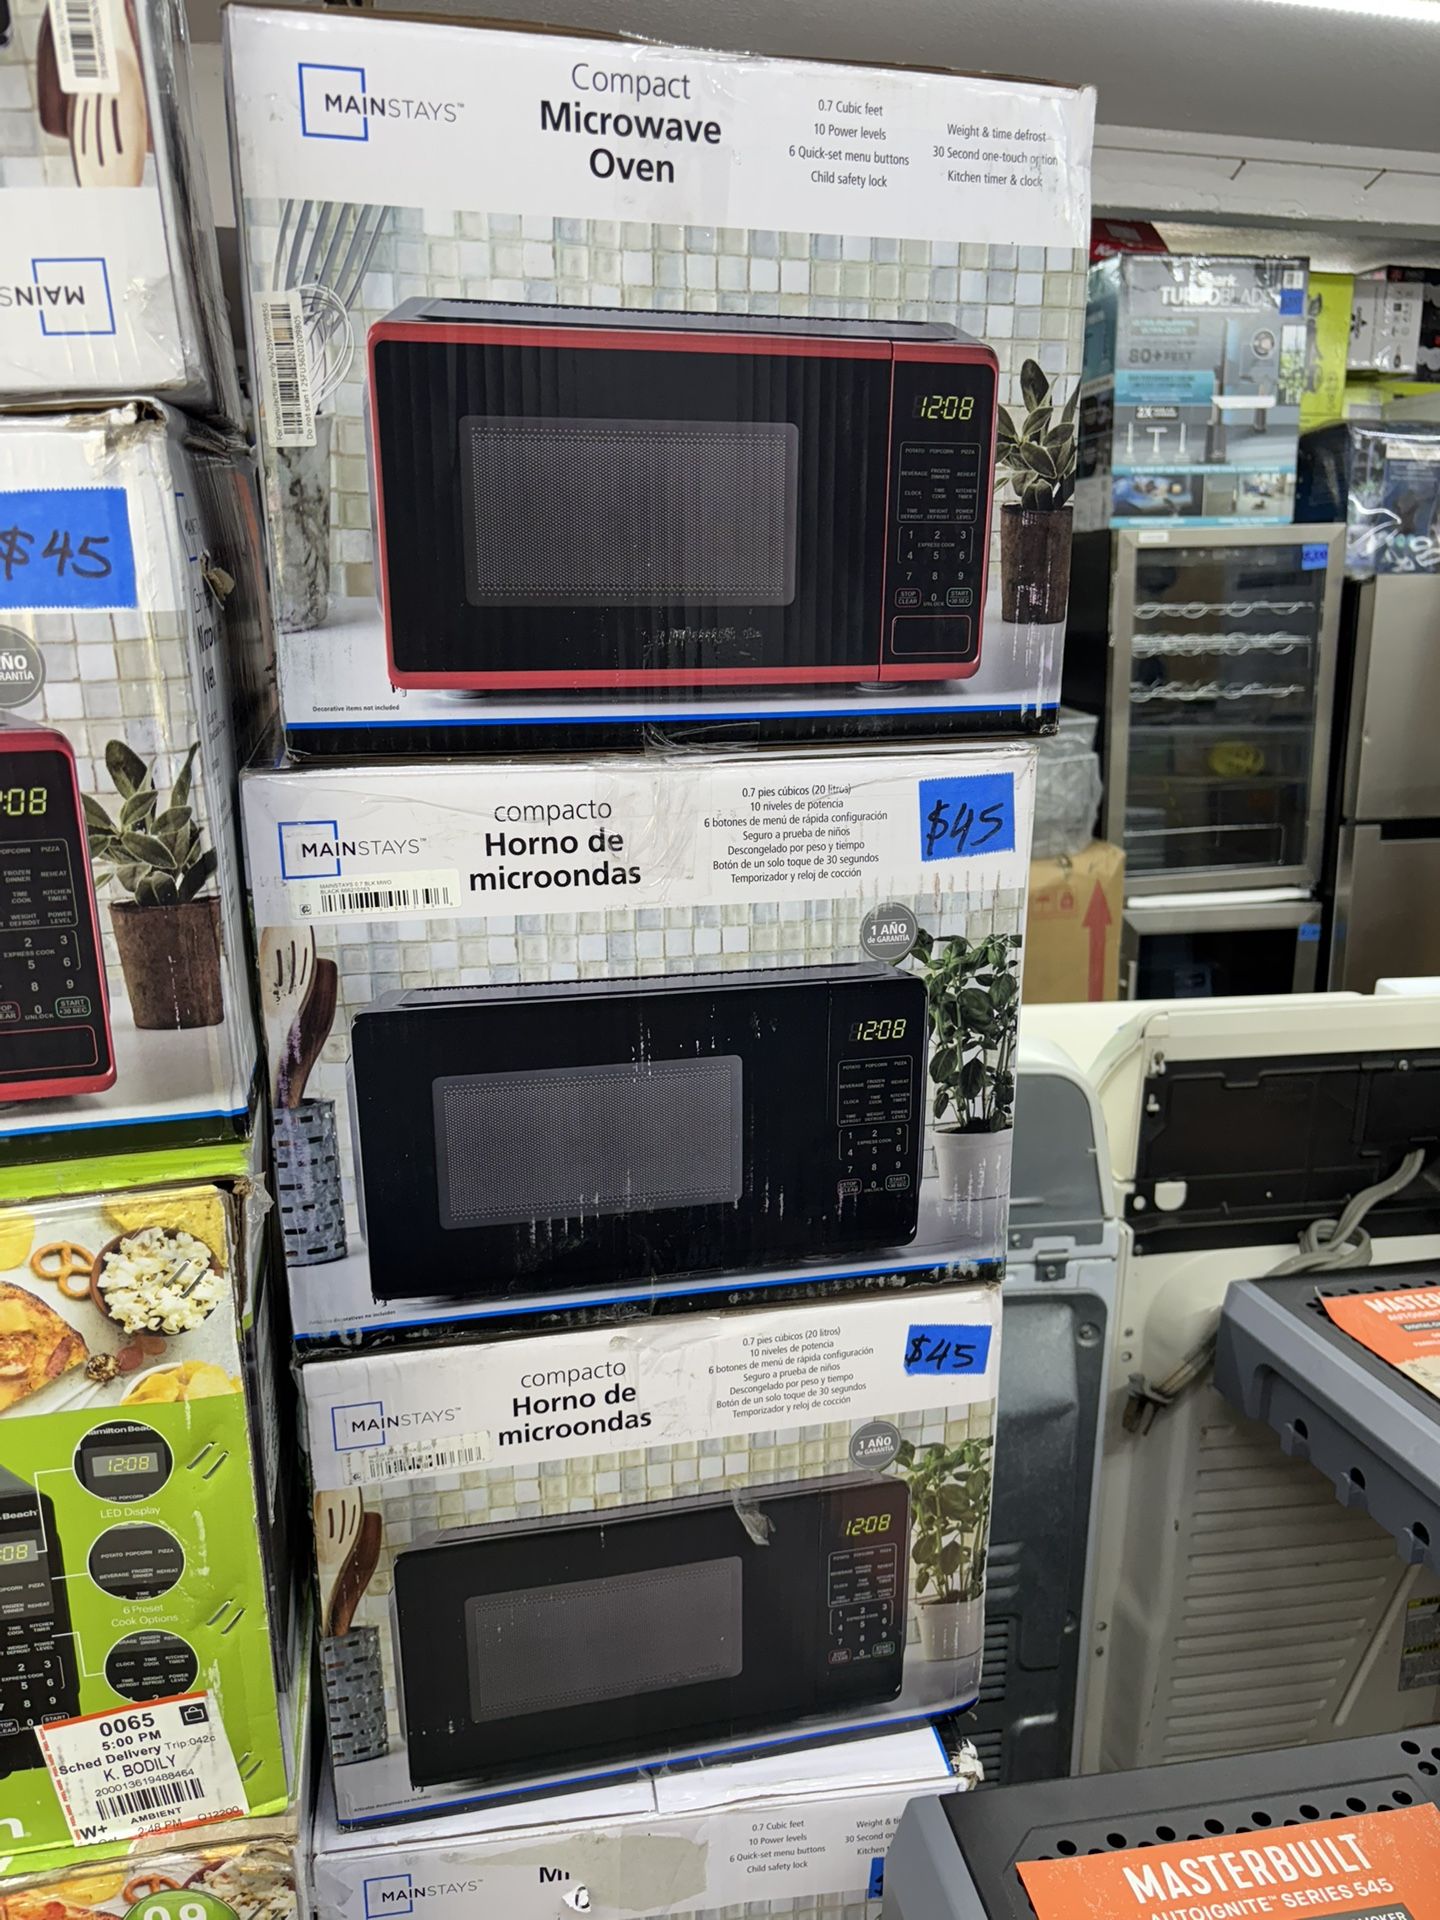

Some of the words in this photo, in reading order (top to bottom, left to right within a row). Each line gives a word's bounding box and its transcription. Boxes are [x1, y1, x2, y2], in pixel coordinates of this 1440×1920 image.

[572, 63, 690, 99] Compact
[818, 99, 833, 111] 0.7
[836, 100, 862, 114] Cubic
[865, 102, 883, 116] feet
[541, 100, 721, 143] Microwave
[814, 123, 826, 135] 10
[828, 124, 858, 138] Power
[861, 126, 886, 140] levels
[947, 123, 979, 140] Weight
[982, 126, 989, 138] &
[992, 128, 1012, 140] time
[1014, 129, 1046, 142] defrost
[789, 145, 796, 157] 6
[798, 145, 842, 160] Quick-set
[845, 152, 871, 162] menu
[874, 151, 909, 166] buttons
[933, 145, 945, 158] 30
[947, 146, 980, 160] Second
[982, 152, 1027, 163] one-touch
[590, 148, 674, 183] Oven
[811, 170, 835, 184] Child
[837, 172, 866, 189] safety
[868, 174, 887, 187] lock
[948, 170, 981, 183] Kitchen
[984, 173, 1007, 185] timer
[1010, 174, 1017, 186] &
[1020, 172, 1042, 187] clock
[920, 395, 975, 420] 12:08
[0, 652, 27, 670] ÑO
[742, 787, 755, 797] 0.7
[758, 789, 775, 799] pies
[777, 786, 809, 796] cúbicos
[812, 784, 826, 795] (20
[751, 801, 761, 811] 10
[763, 800, 792, 811] niveles
[794, 800, 805, 810] de
[807, 797, 844, 811] potencia
[494, 800, 612, 826] compacto
[704, 818, 710, 828] 6
[712, 817, 747, 827] botones
[749, 816, 760, 826] de
[762, 815, 787, 825] menú
[789, 814, 800, 824] de
[802, 813, 829, 825] rápida
[831, 811, 887, 824] configuración
[743, 831, 773, 843] Seguro
[775, 831, 780, 839] a
[783, 828, 812, 841] prueba
[815, 827, 826, 837] de
[828, 827, 850, 836] niños
[926, 799, 1004, 856] $45
[485, 832, 578, 856] Horno
[588, 827, 623, 852] de
[728, 843, 787, 856] Descongelado
[789, 845, 804, 854] por
[806, 843, 826, 854] peso
[828, 843, 833, 853] y
[836, 841, 865, 851] tiempo
[713, 860, 739, 870] Botón
[740, 859, 752, 869] de
[754, 860, 765, 868] un
[767, 857, 785, 867] solo
[787, 858, 811, 868] toque
[813, 855, 824, 865] de
[827, 855, 837, 865] 30
[839, 853, 879, 865] segundos
[470, 861, 641, 891] microondas
[731, 871, 788, 884] Temporizador
[790, 873, 795, 883] y
[797, 870, 816, 881] reloj
[818, 869, 829, 879] de
[830, 868, 861, 878] cocción
[871, 925, 876, 935] 1
[880, 919, 907, 934] AÑO
[876, 932, 910, 942] GARANTÍA
[857, 1019, 906, 1041] 12:08
[743, 1337, 755, 1346] 0.7
[757, 1335, 773, 1346] pies
[805, 1329, 818, 1340] (20
[819, 1326, 841, 1337] litros)
[905, 1334, 976, 1369] $45
[521, 1362, 626, 1388] compacto
[513, 1393, 595, 1417] Horno
[604, 1383, 636, 1404] de
[499, 1410, 651, 1446] microondas
[859, 1440, 864, 1449] 1
[868, 1436, 892, 1448] AÑO
[108, 1456, 150, 1472] 12:08
[2, 1510, 37, 1520] Beach
[100, 1509, 121, 1518] LED
[125, 1506, 160, 1517] Display
[123, 1606, 130, 1614] 6
[132, 1604, 163, 1613] Preset
[111, 1617, 137, 1627] Cook
[139, 1614, 178, 1625] Options
[99, 1712, 155, 1737] 0065
[102, 1736, 134, 1751] 5:00
[138, 1730, 162, 1742] PM
[59, 1757, 102, 1775] Sched
[106, 1745, 161, 1764] Delivery
[103, 1768, 120, 1782] K.
[122, 1755, 176, 1778] BODILY
[131, 1807, 182, 1824] AMBIENT
[856, 1819, 883, 1829] Weight
[80, 1825, 108, 1839] W+
[164, 1818, 183, 1831] PM
[752, 1823, 764, 1832] 0.7
[766, 1822, 787, 1830] Cubic
[789, 1820, 804, 1828] feet
[786, 1833, 807, 1842] levels
[845, 1835, 854, 1843] 30
[856, 1833, 883, 1842] Second
[729, 1855, 735, 1863] 6
[736, 1851, 772, 1861] Quick-set
[797, 1846, 826, 1855] buttons
[857, 1846, 885, 1855] Kitchen
[746, 1864, 766, 1873] Child
[768, 1863, 791, 1871] safety
[793, 1860, 807, 1868] lock
[1122, 1833, 1373, 1904] MASTERBUILT
[1281, 1884, 1354, 1908] SERIES
[1354, 1878, 1394, 1899] 545
